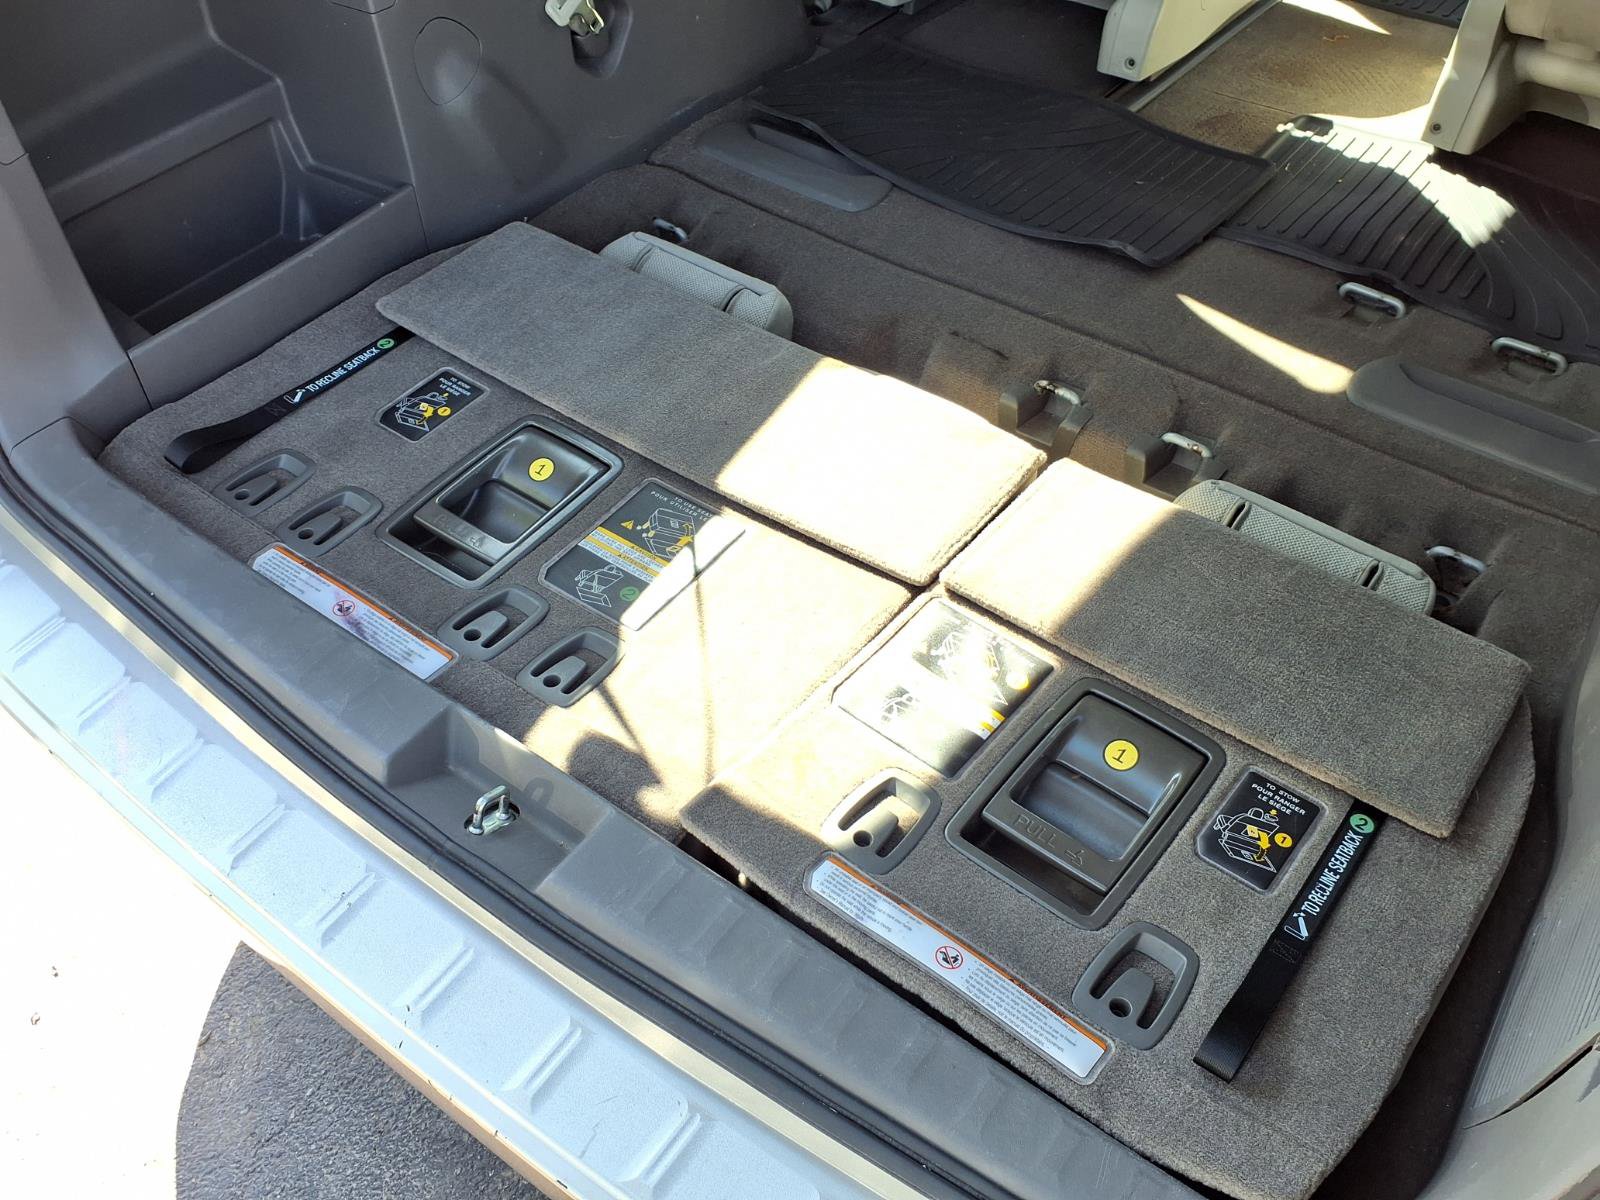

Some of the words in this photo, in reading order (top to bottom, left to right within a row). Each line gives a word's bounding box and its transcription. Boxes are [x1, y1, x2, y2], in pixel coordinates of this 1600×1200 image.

[305, 382, 319, 393] TO
[316, 366, 347, 388] RECLINE
[345, 347, 381, 370] SEATBACK
[651, 491, 668, 501] POUR
[683, 499, 696, 509] USE
[1251, 783, 1274, 797] POUR
[1274, 795, 1306, 815] RANGER
[1257, 794, 1268, 802] LE
[1266, 783, 1276, 791] TO
[1279, 790, 1300, 803] STOW
[1012, 815, 1056, 849] PULL
[1331, 831, 1363, 874] SEATBACK
[1310, 869, 1340, 904] RECLINE
[1302, 900, 1320, 916] TO
